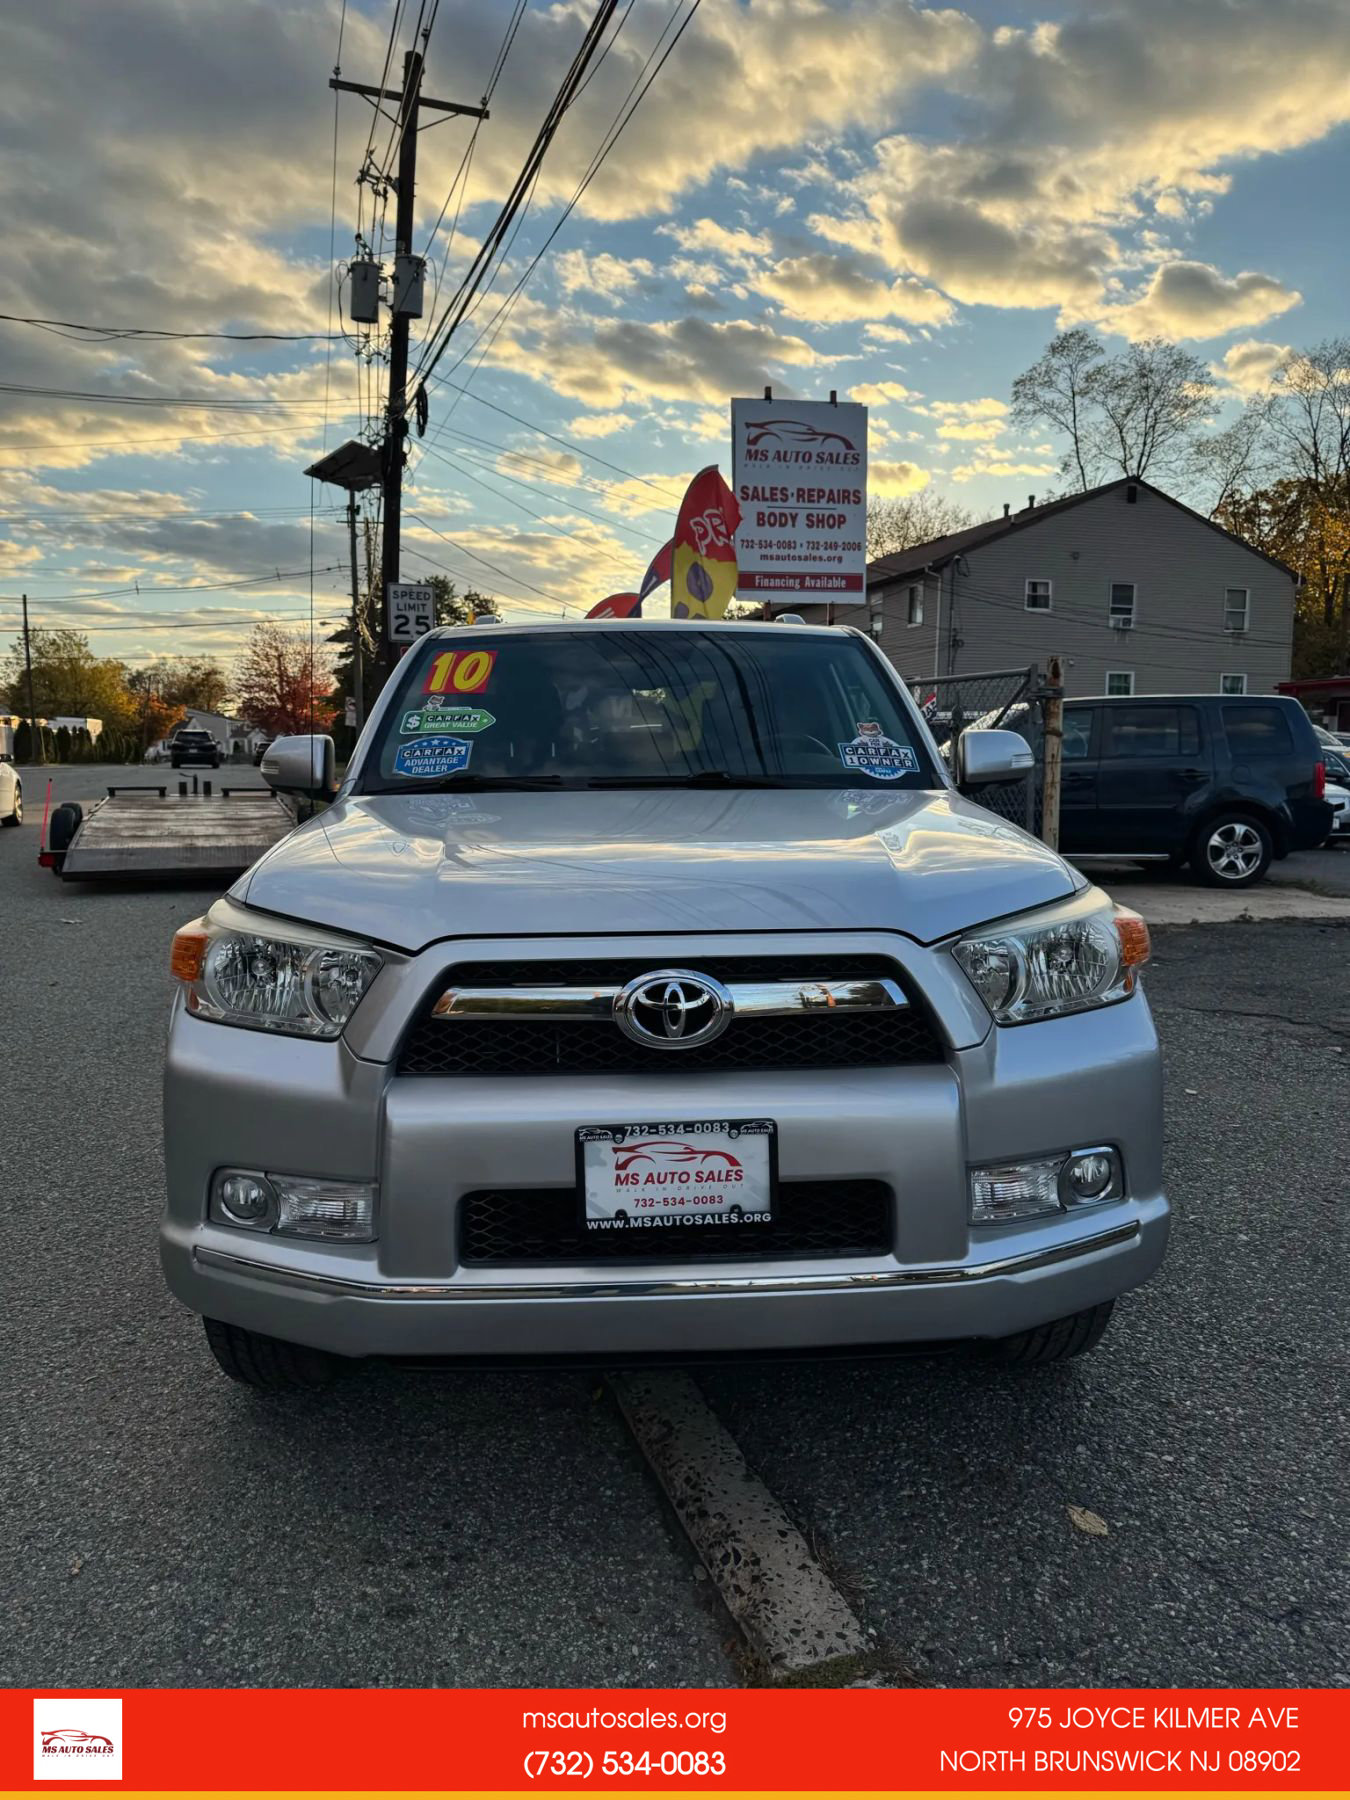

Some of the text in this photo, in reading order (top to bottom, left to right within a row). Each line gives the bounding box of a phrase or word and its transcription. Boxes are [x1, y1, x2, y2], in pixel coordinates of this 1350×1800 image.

[745, 449, 860, 465] MS AUTO SALES
[740, 485, 862, 505] SALES REPAIRS
[756, 511, 847, 529] BODY SHOP
[740, 538, 862, 551] 732-534-0083 732-249-2006
[760, 553, 843, 563] msautosales.org
[755, 575, 846, 589] Financing Available
[392, 590, 431, 601] SPEED
[396, 603, 427, 612] LIMIT
[394, 614, 431, 635] 25
[429, 651, 492, 692] 10
[403, 746, 466, 758] CARFAX
[845, 747, 912, 758] CARFAX
[404, 757, 459, 767] ADVANTAGE
[412, 764, 448, 774] DEALER
[624, 1122, 730, 1137] 732-534-0083
[615, 1169, 744, 1186] MS AUTO SALES
[634, 1195, 723, 1208] 732-534-0083
